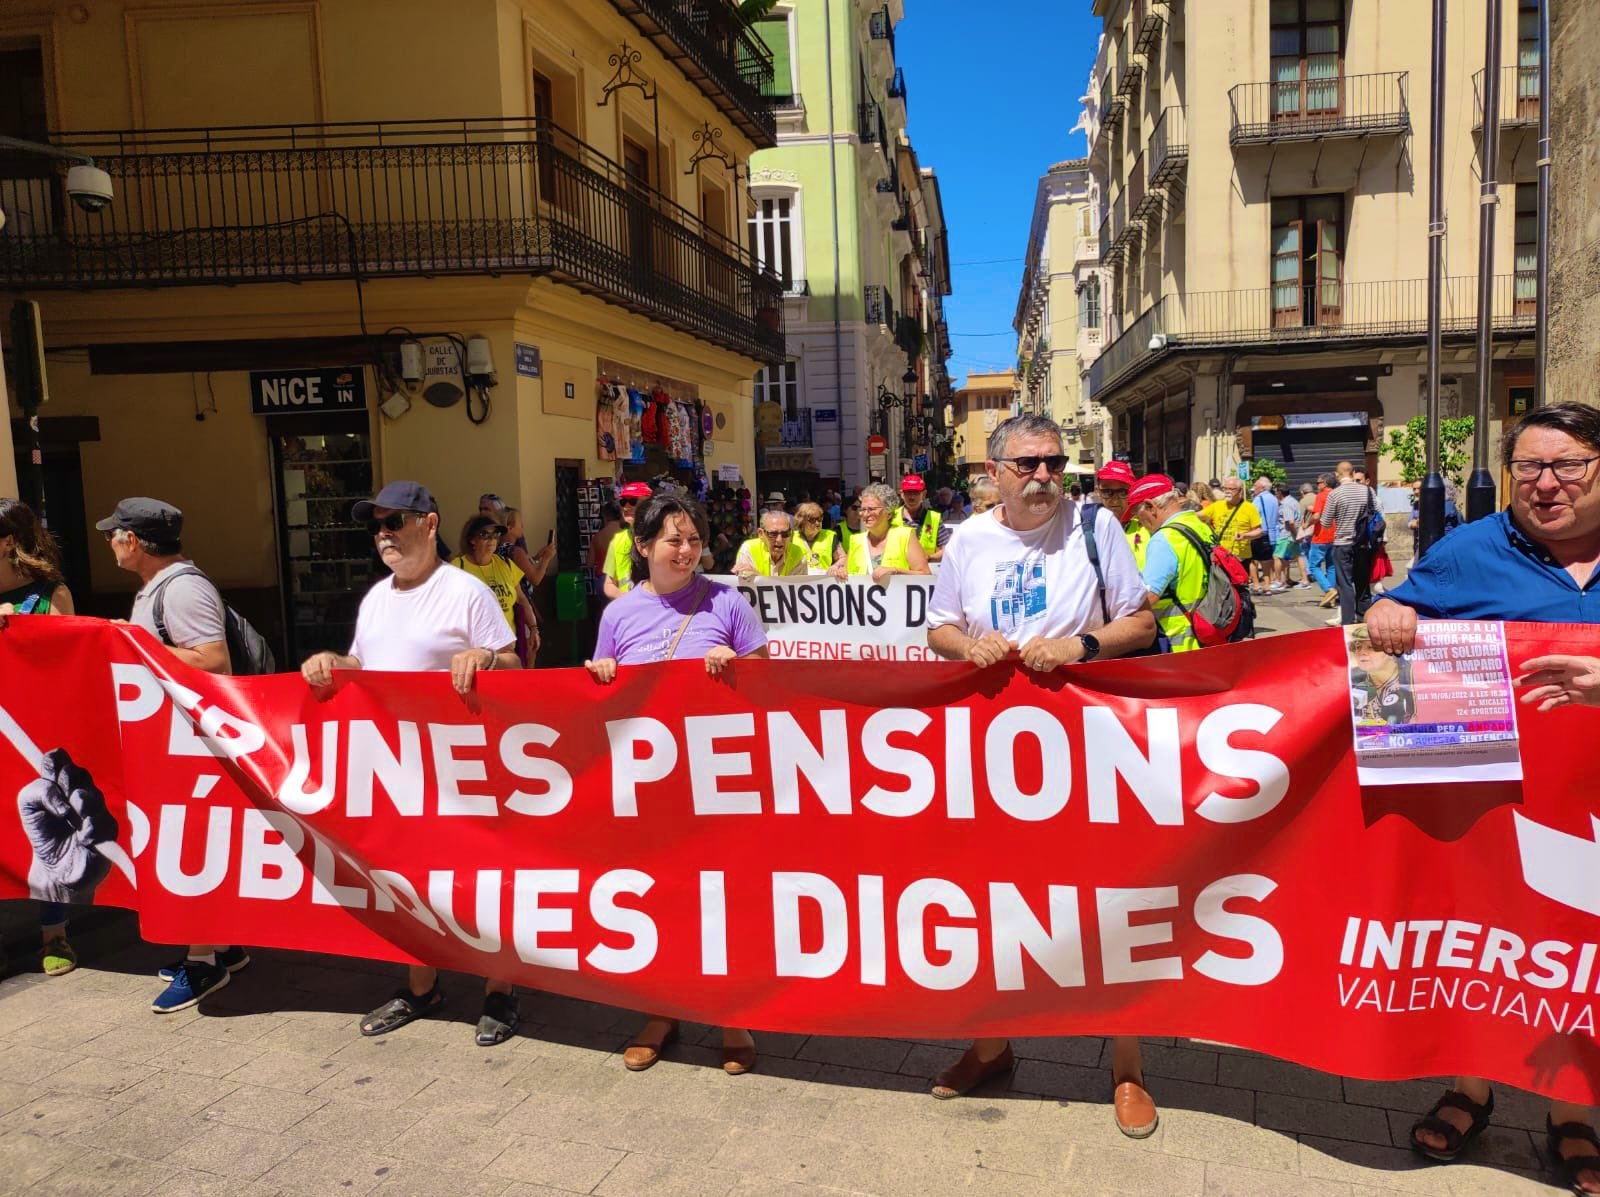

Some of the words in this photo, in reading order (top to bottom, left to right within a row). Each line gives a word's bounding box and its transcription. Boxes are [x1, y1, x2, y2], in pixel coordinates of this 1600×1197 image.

[429, 346, 453, 354] CALLE
[436, 357, 446, 365] DE
[261, 377, 323, 406] NiCE
[337, 390, 353, 403] IN
[737, 584, 887, 627] PENSIONS
[1417, 623, 1470, 633] ENTRADES
[1474, 623, 1481, 632] A
[1485, 623, 1497, 632] LA
[1424, 635, 1458, 646] VENDA
[767, 640, 852, 660] OVERNE
[1404, 648, 1448, 661] CONCERT
[1428, 661, 1453, 673] AMB
[1455, 658, 1502, 672] AMPARO
[1437, 724, 1455, 733] PER
[1457, 724, 1465, 733] A
[1388, 735, 1404, 747] NO
[279, 719, 574, 818] UNES
[605, 703, 1291, 826] PENSIONS
[700, 870, 728, 976] I
[772, 872, 1285, 992] DIGNES
[1339, 915, 1600, 995] INTERSI
[1338, 973, 1596, 1037] VALENCIANA
